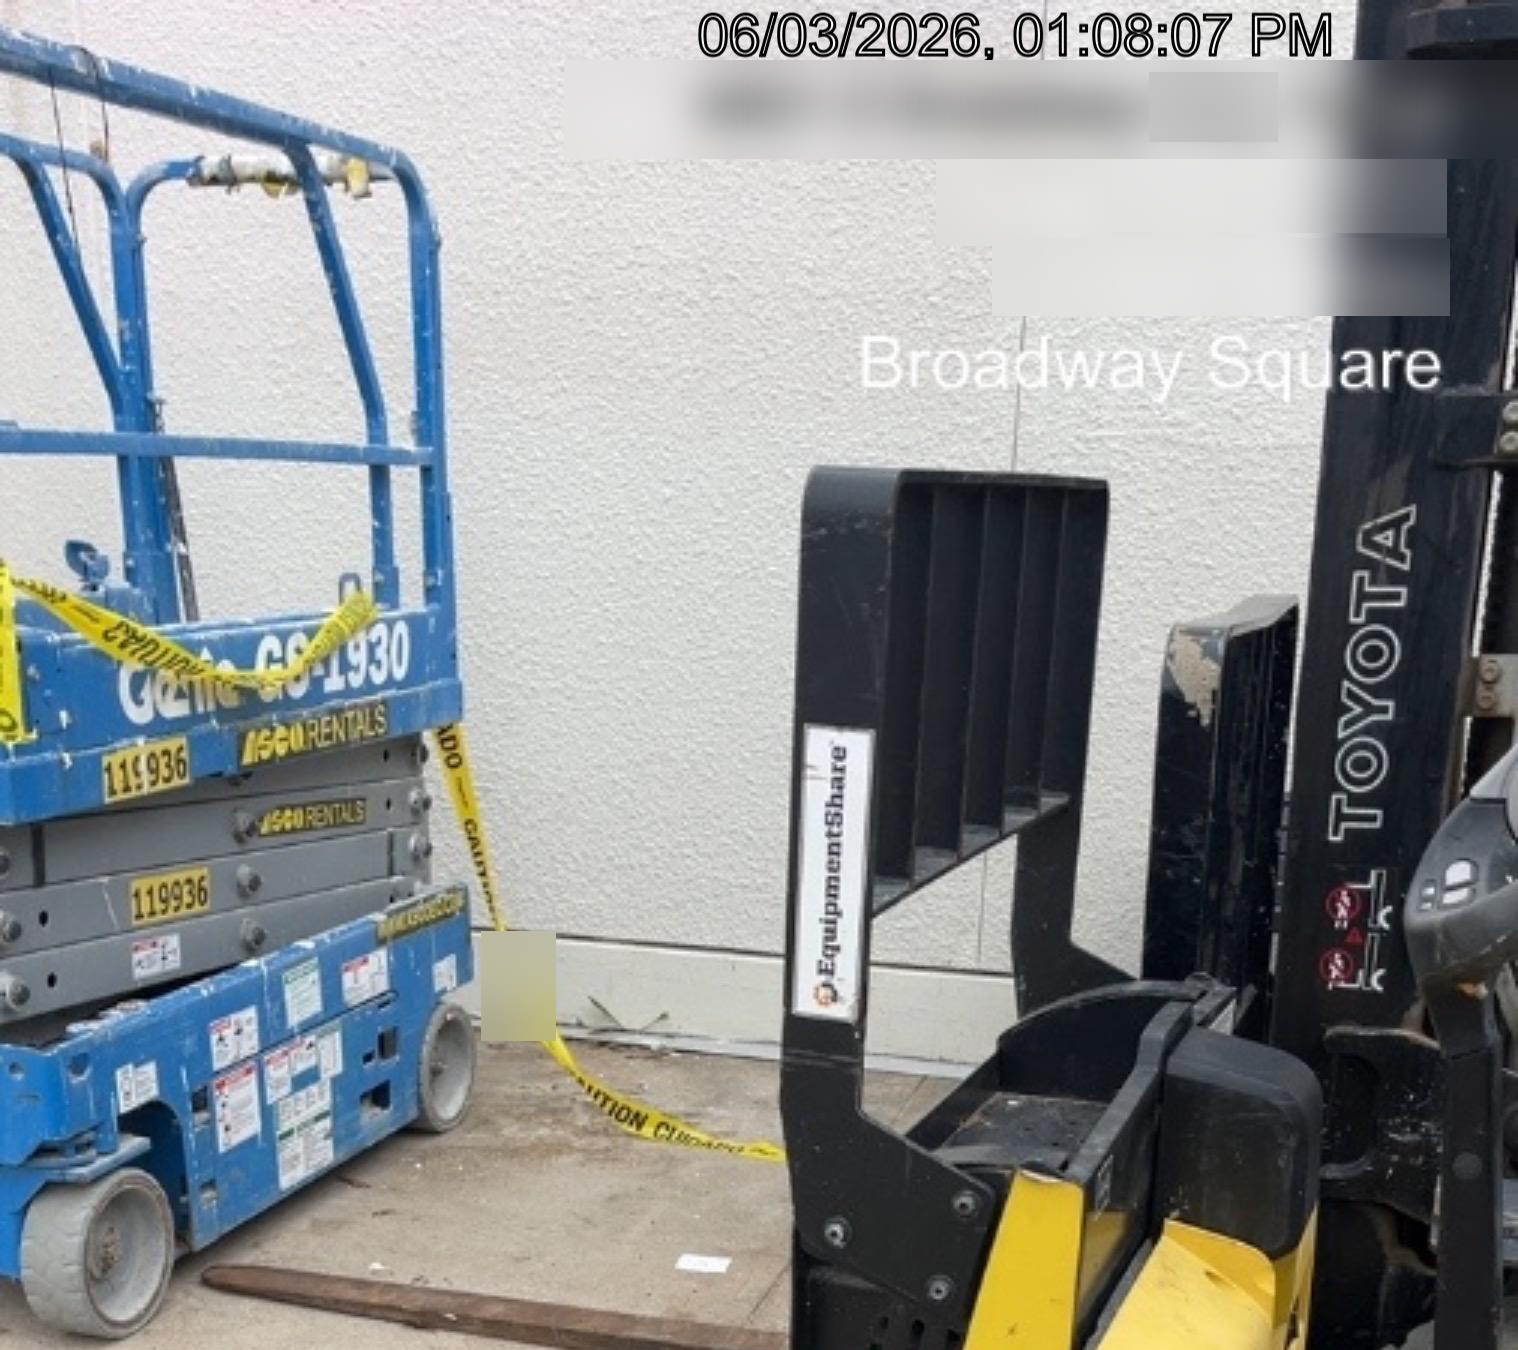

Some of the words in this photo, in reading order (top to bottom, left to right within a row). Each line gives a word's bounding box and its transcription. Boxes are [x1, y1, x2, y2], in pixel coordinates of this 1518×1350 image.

[1328, 504, 1416, 841] TOYOTA
[132, 875, 209, 921] 119936
[816, 745, 847, 977] EquipmentShare
